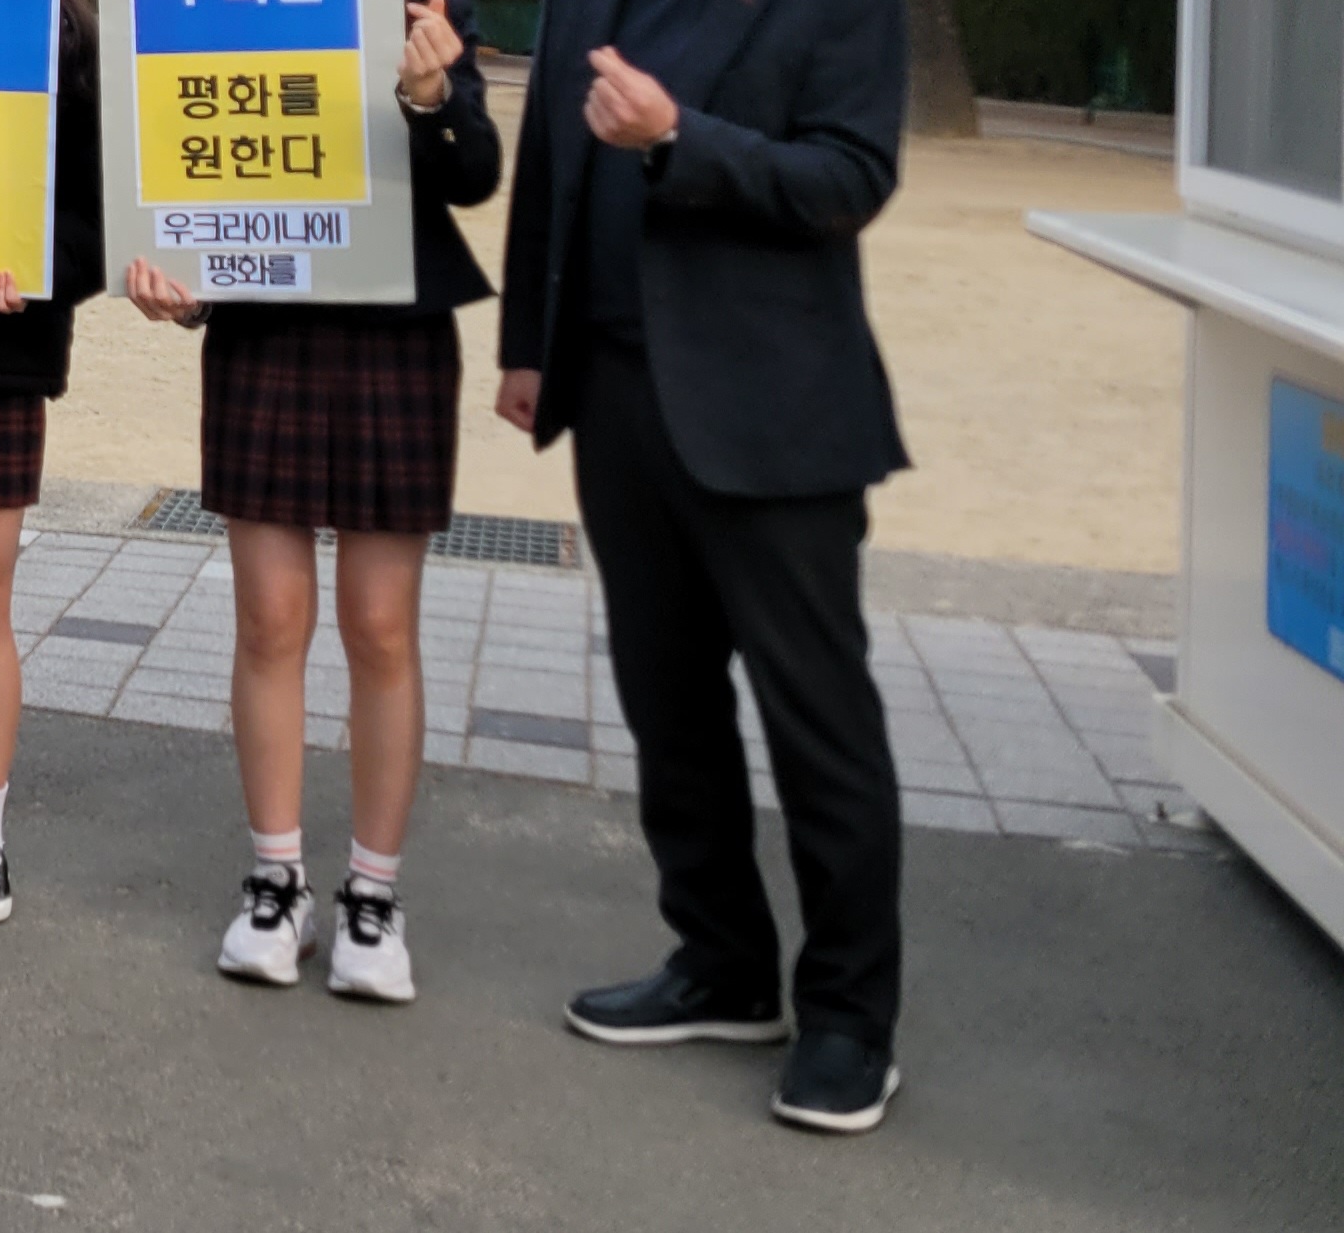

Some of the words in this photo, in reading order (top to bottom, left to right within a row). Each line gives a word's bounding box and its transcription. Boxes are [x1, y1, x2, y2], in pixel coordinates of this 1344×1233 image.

[178, 73, 321, 120] 평화를
[181, 134, 326, 180] 원한다
[163, 211, 342, 245] 우크라이나에
[207, 253, 297, 287] 평화를
